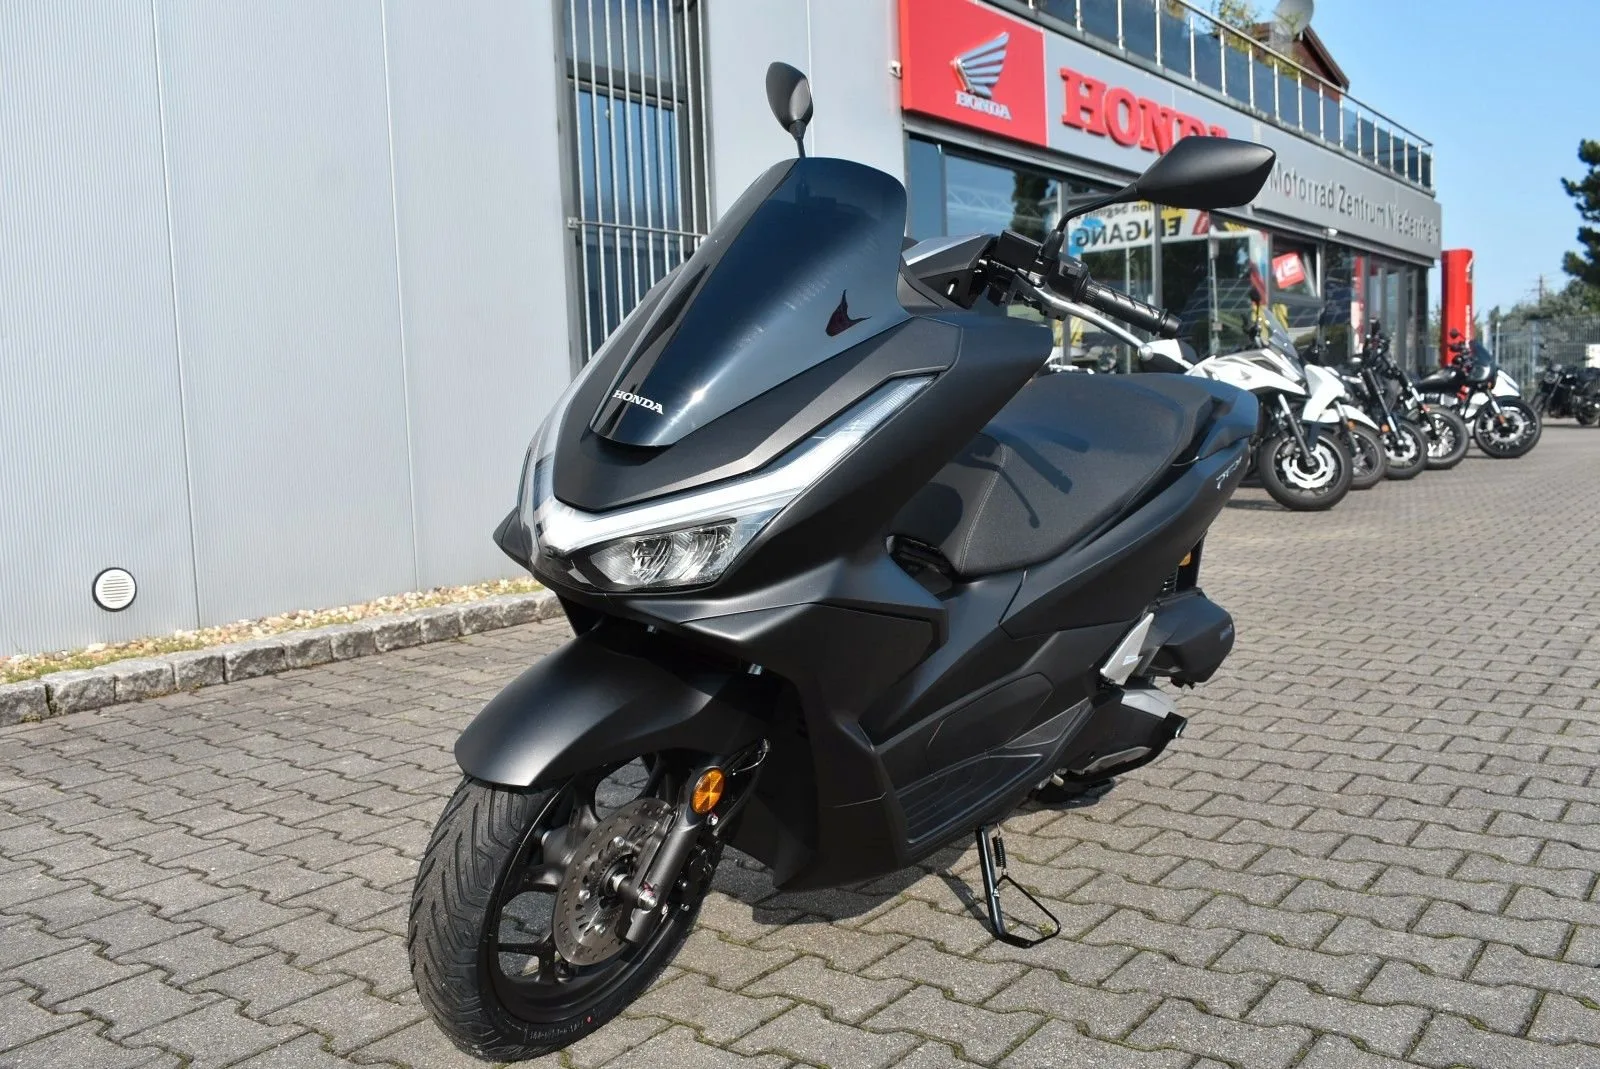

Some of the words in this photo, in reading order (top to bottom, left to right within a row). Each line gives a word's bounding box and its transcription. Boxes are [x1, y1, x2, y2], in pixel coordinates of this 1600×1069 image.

[955, 89, 1012, 120] HONDA
[1060, 67, 1228, 155] HOND
[1268, 159, 1334, 209] Motorrad
[1337, 184, 1385, 227] Zentrum
[612, 389, 664, 415] HONDA
